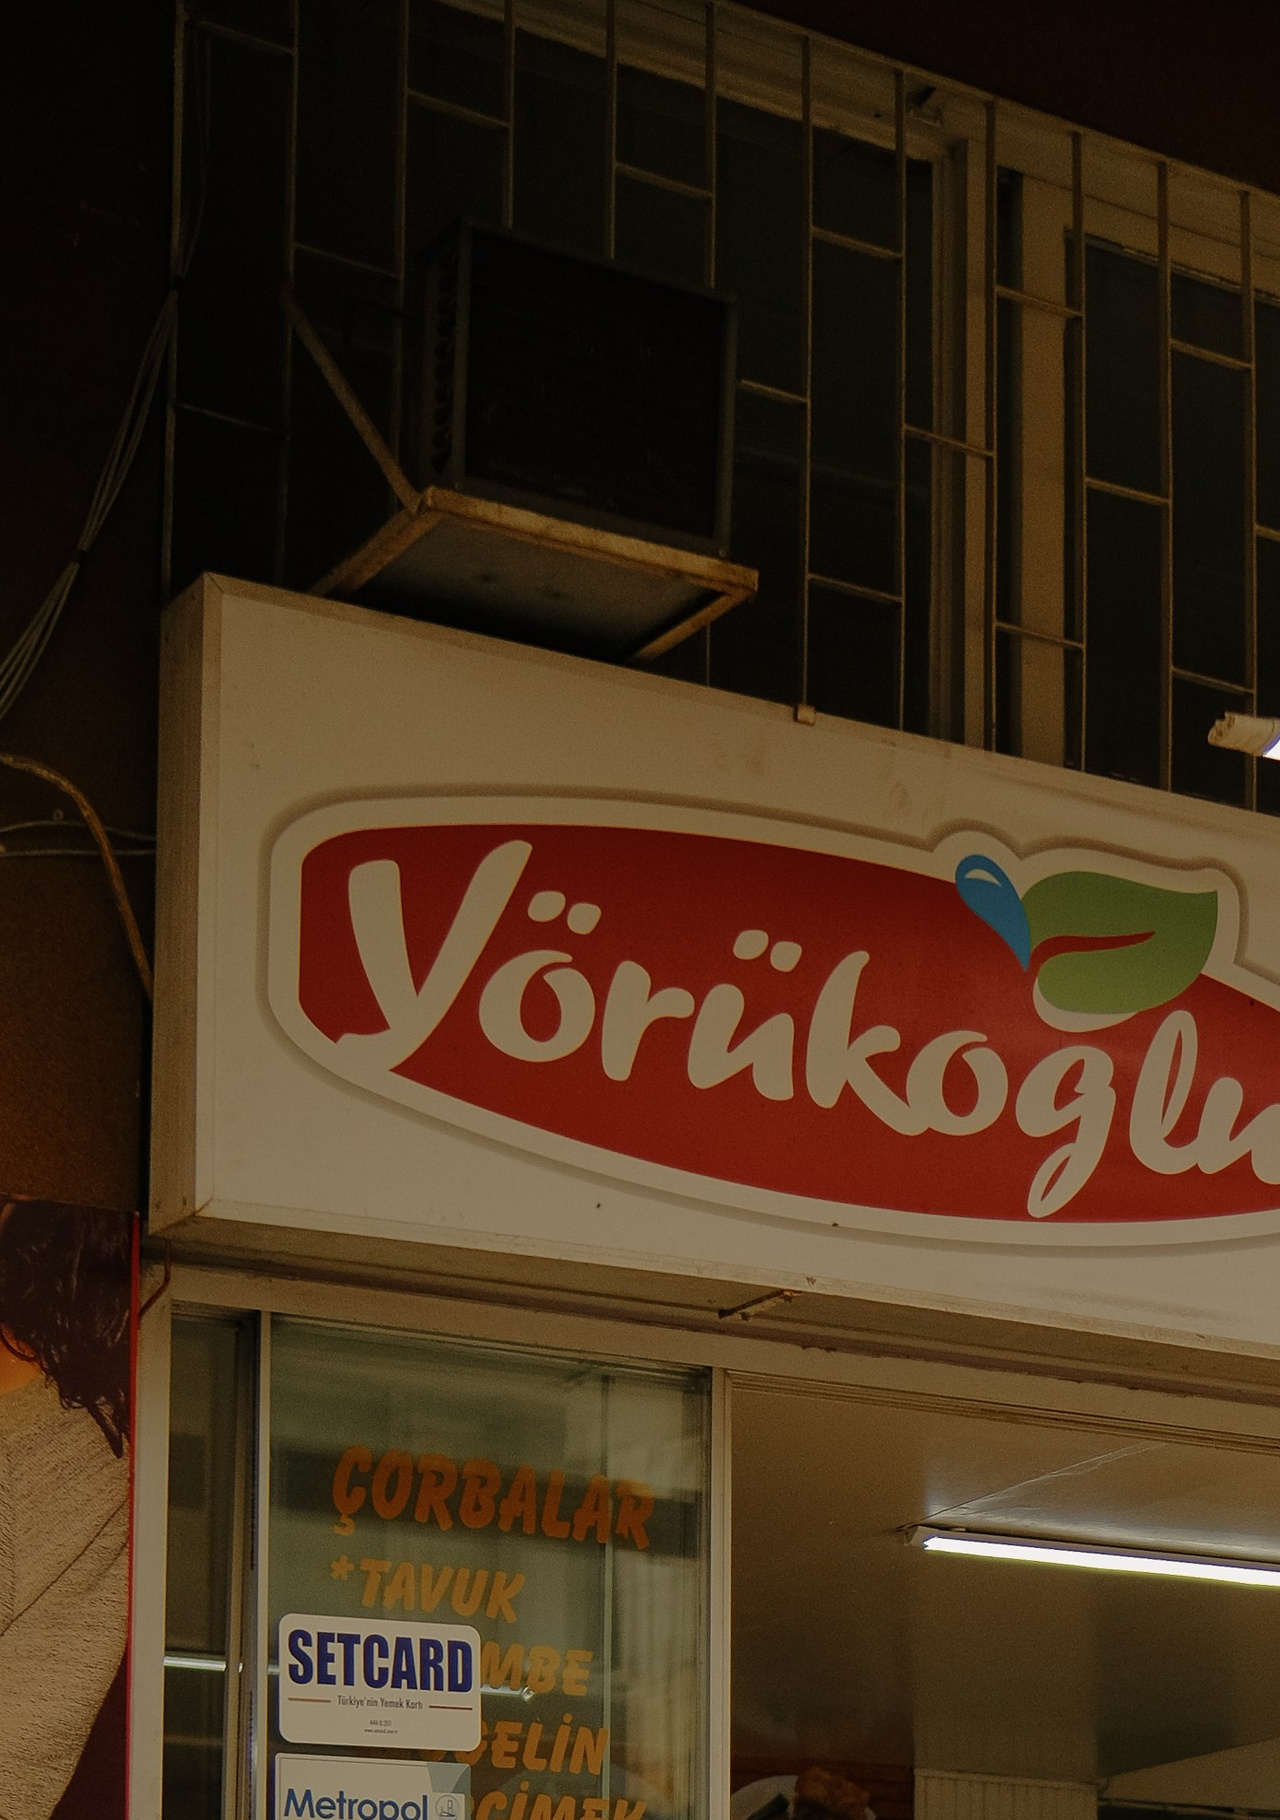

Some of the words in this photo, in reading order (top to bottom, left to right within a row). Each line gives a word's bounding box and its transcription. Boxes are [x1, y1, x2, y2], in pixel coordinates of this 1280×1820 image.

[333, 1446, 655, 1549] ÇORBALAR
[288, 1629, 473, 1693] SETCARD
[481, 1641, 594, 1697] MBE
[380, 1697, 404, 1708] Yemek
